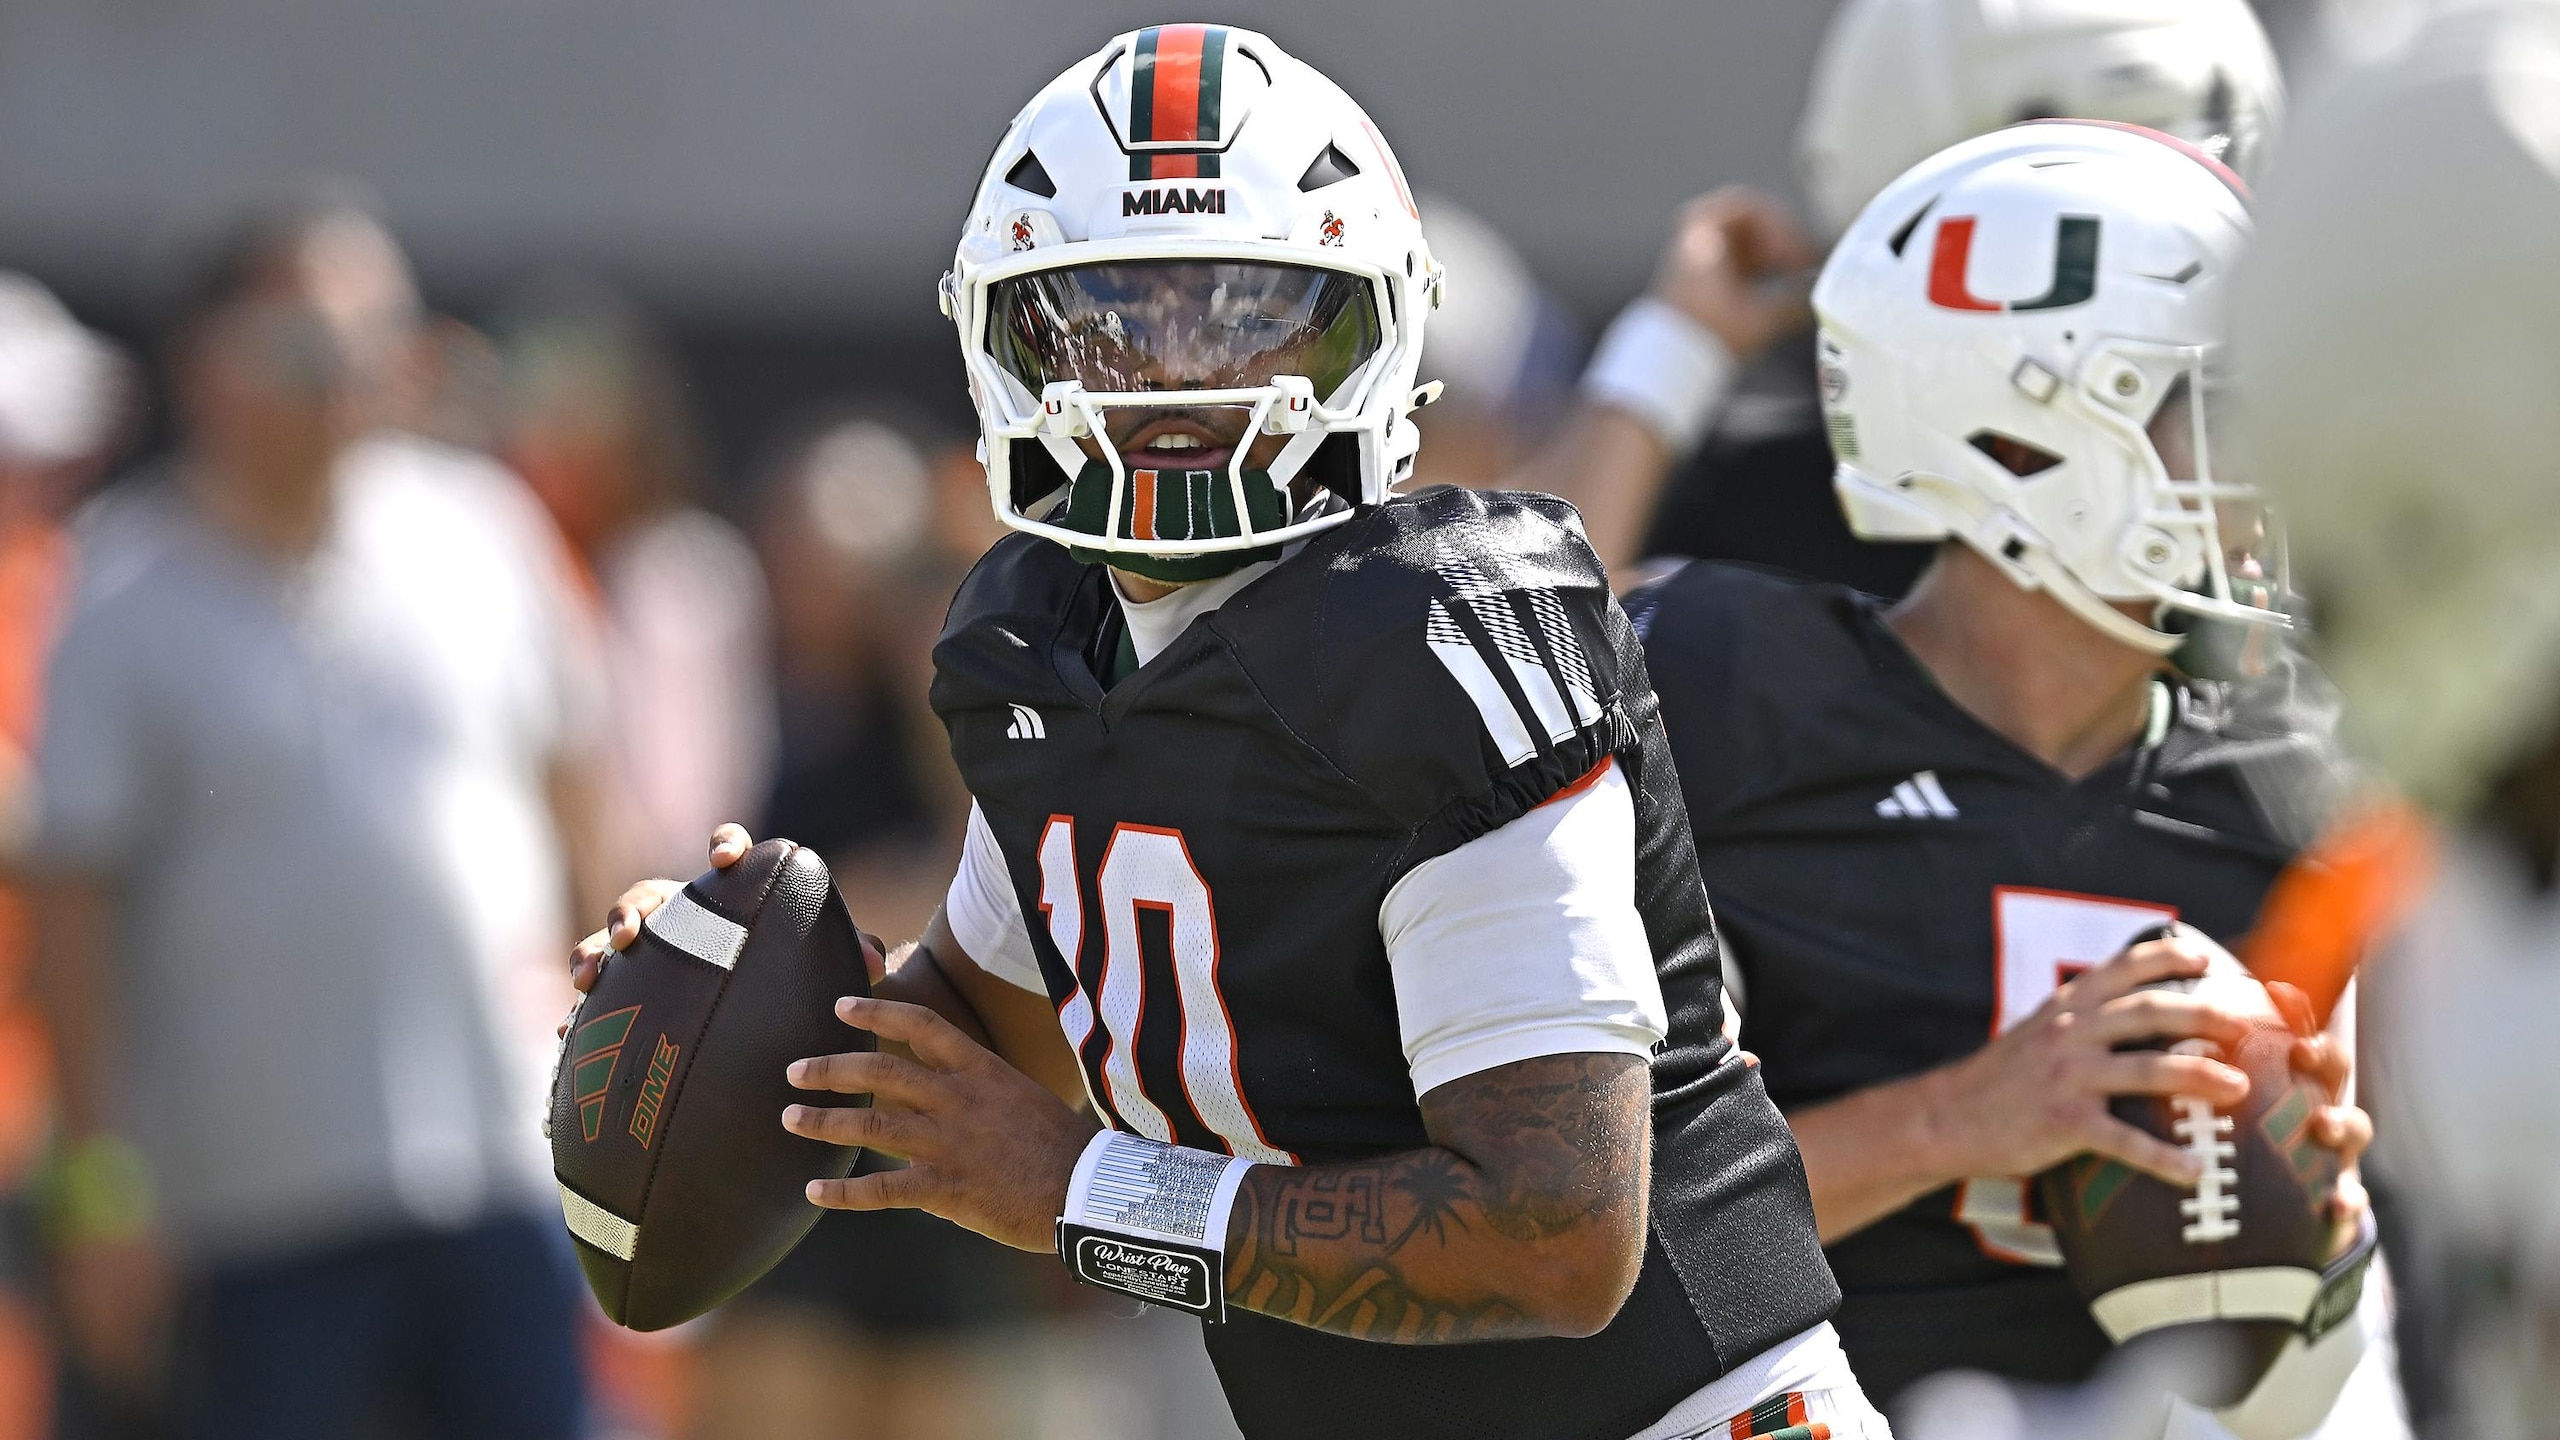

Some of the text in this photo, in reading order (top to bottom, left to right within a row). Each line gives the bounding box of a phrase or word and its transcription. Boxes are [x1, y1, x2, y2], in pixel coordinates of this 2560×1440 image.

[1122, 188, 1225, 217] MIAMI
[1928, 214, 2103, 314] U
[1045, 399, 1062, 415] U
[1289, 396, 1309, 412] U
[1037, 813, 1301, 1167] 10
[628, 1031, 681, 1151] DIME
[1093, 1245, 1192, 1275] Wrist Plan
